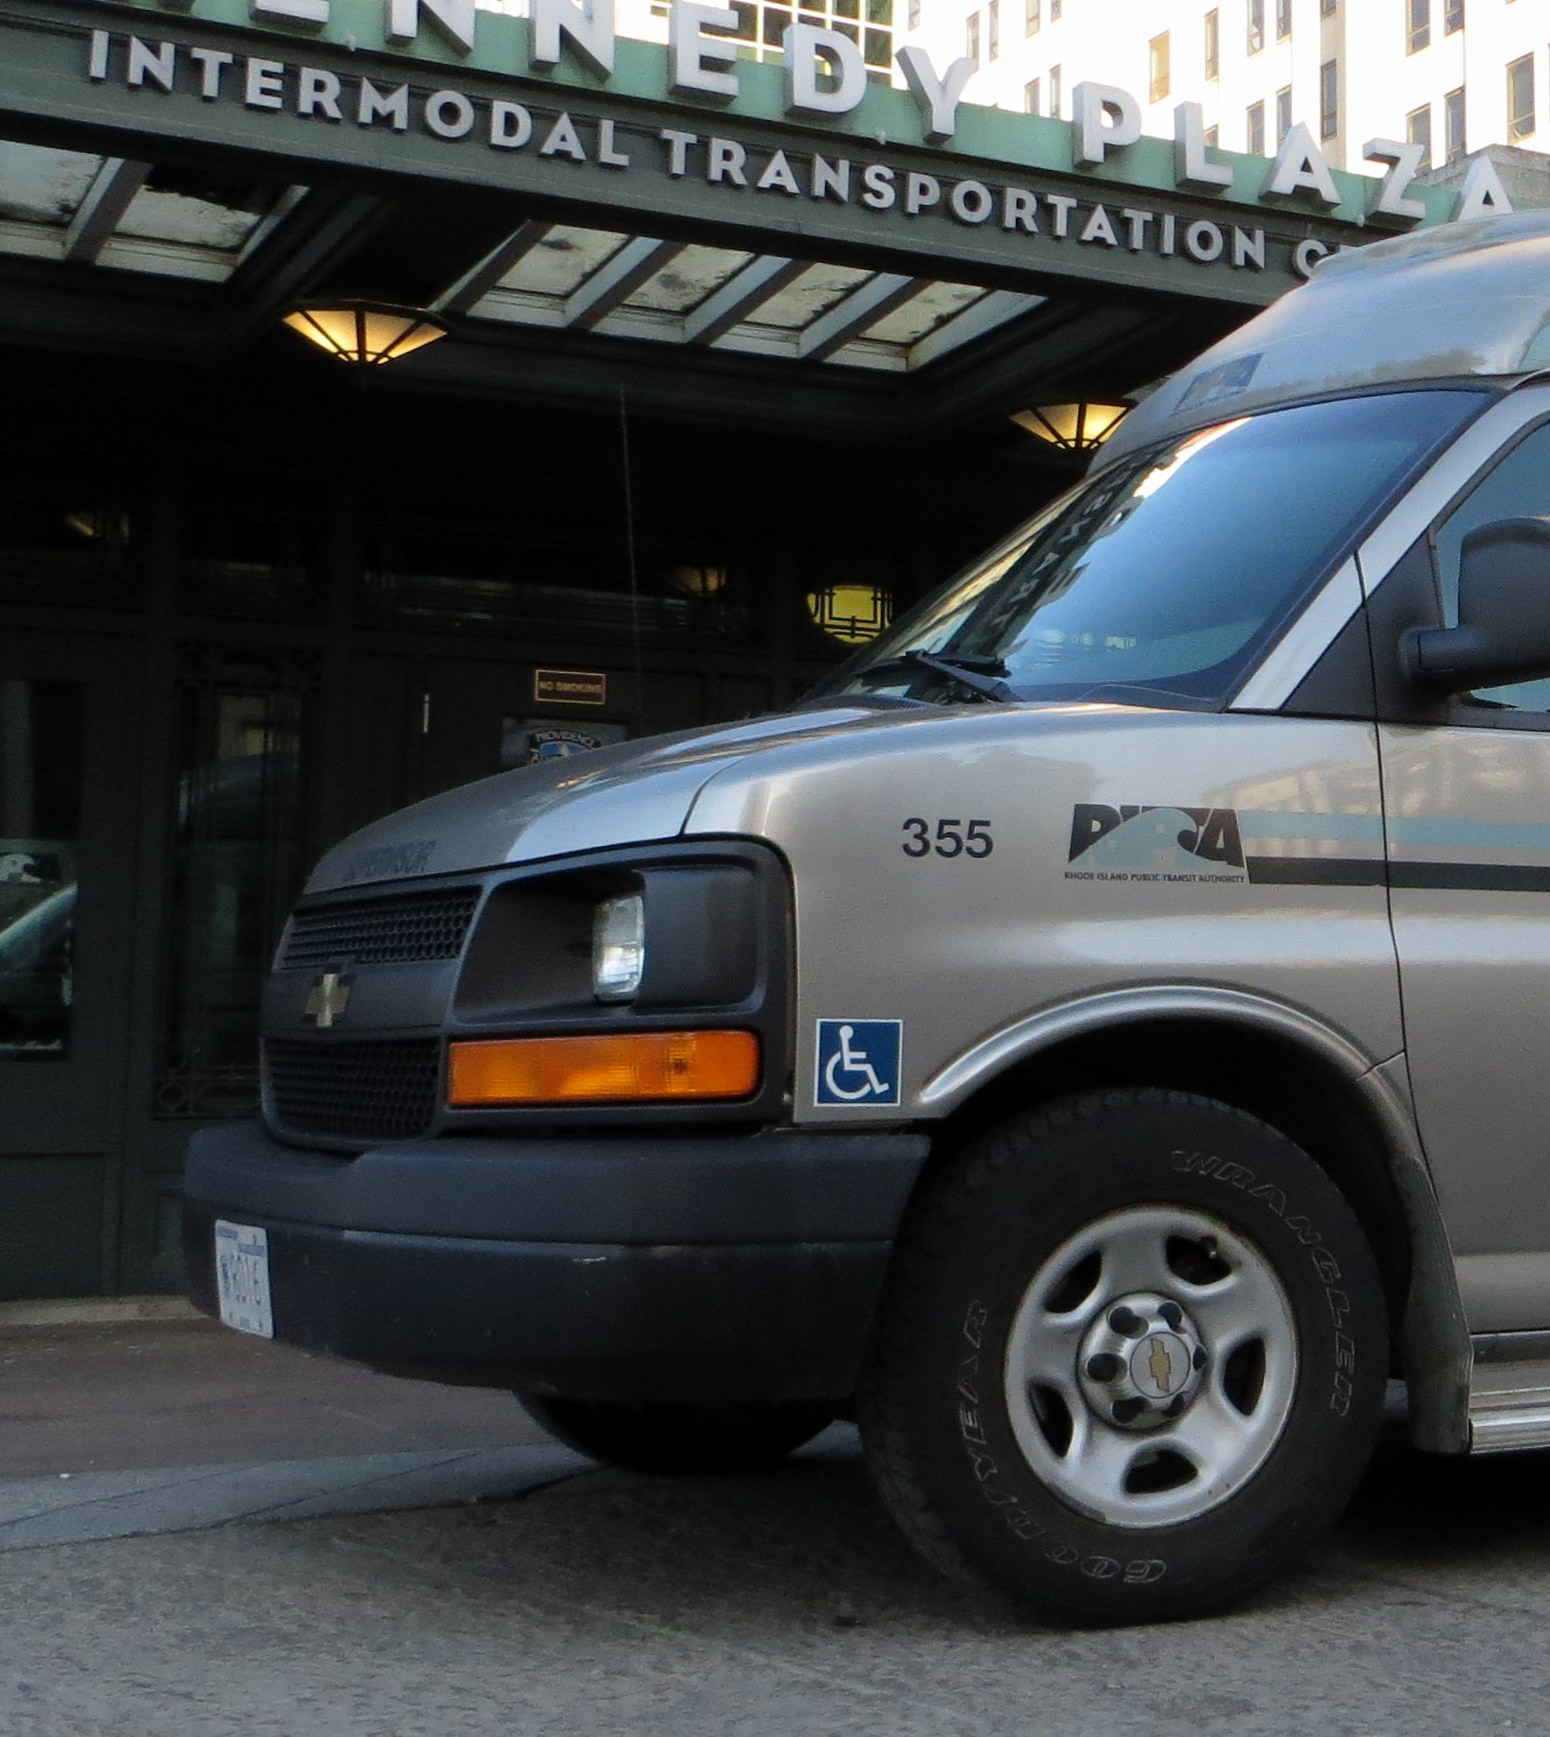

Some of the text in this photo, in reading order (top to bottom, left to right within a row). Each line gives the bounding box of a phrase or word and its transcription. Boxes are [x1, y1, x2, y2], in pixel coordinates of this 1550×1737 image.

[89, 29, 631, 169] INTERMODAL
[659, 128, 1265, 270] TRANSPORTATION
[1073, 81, 1513, 227] PLAZA
[539, 681, 603, 694] NO SMOKING
[902, 817, 994, 858] 355
[1064, 872, 1245, 884] RHODE ISLAND PUBLIC TRANSIT AUTHORITY
[1171, 1149, 1358, 1418] WRANGLER
[957, 1298, 1167, 1585] GOODYEAR
